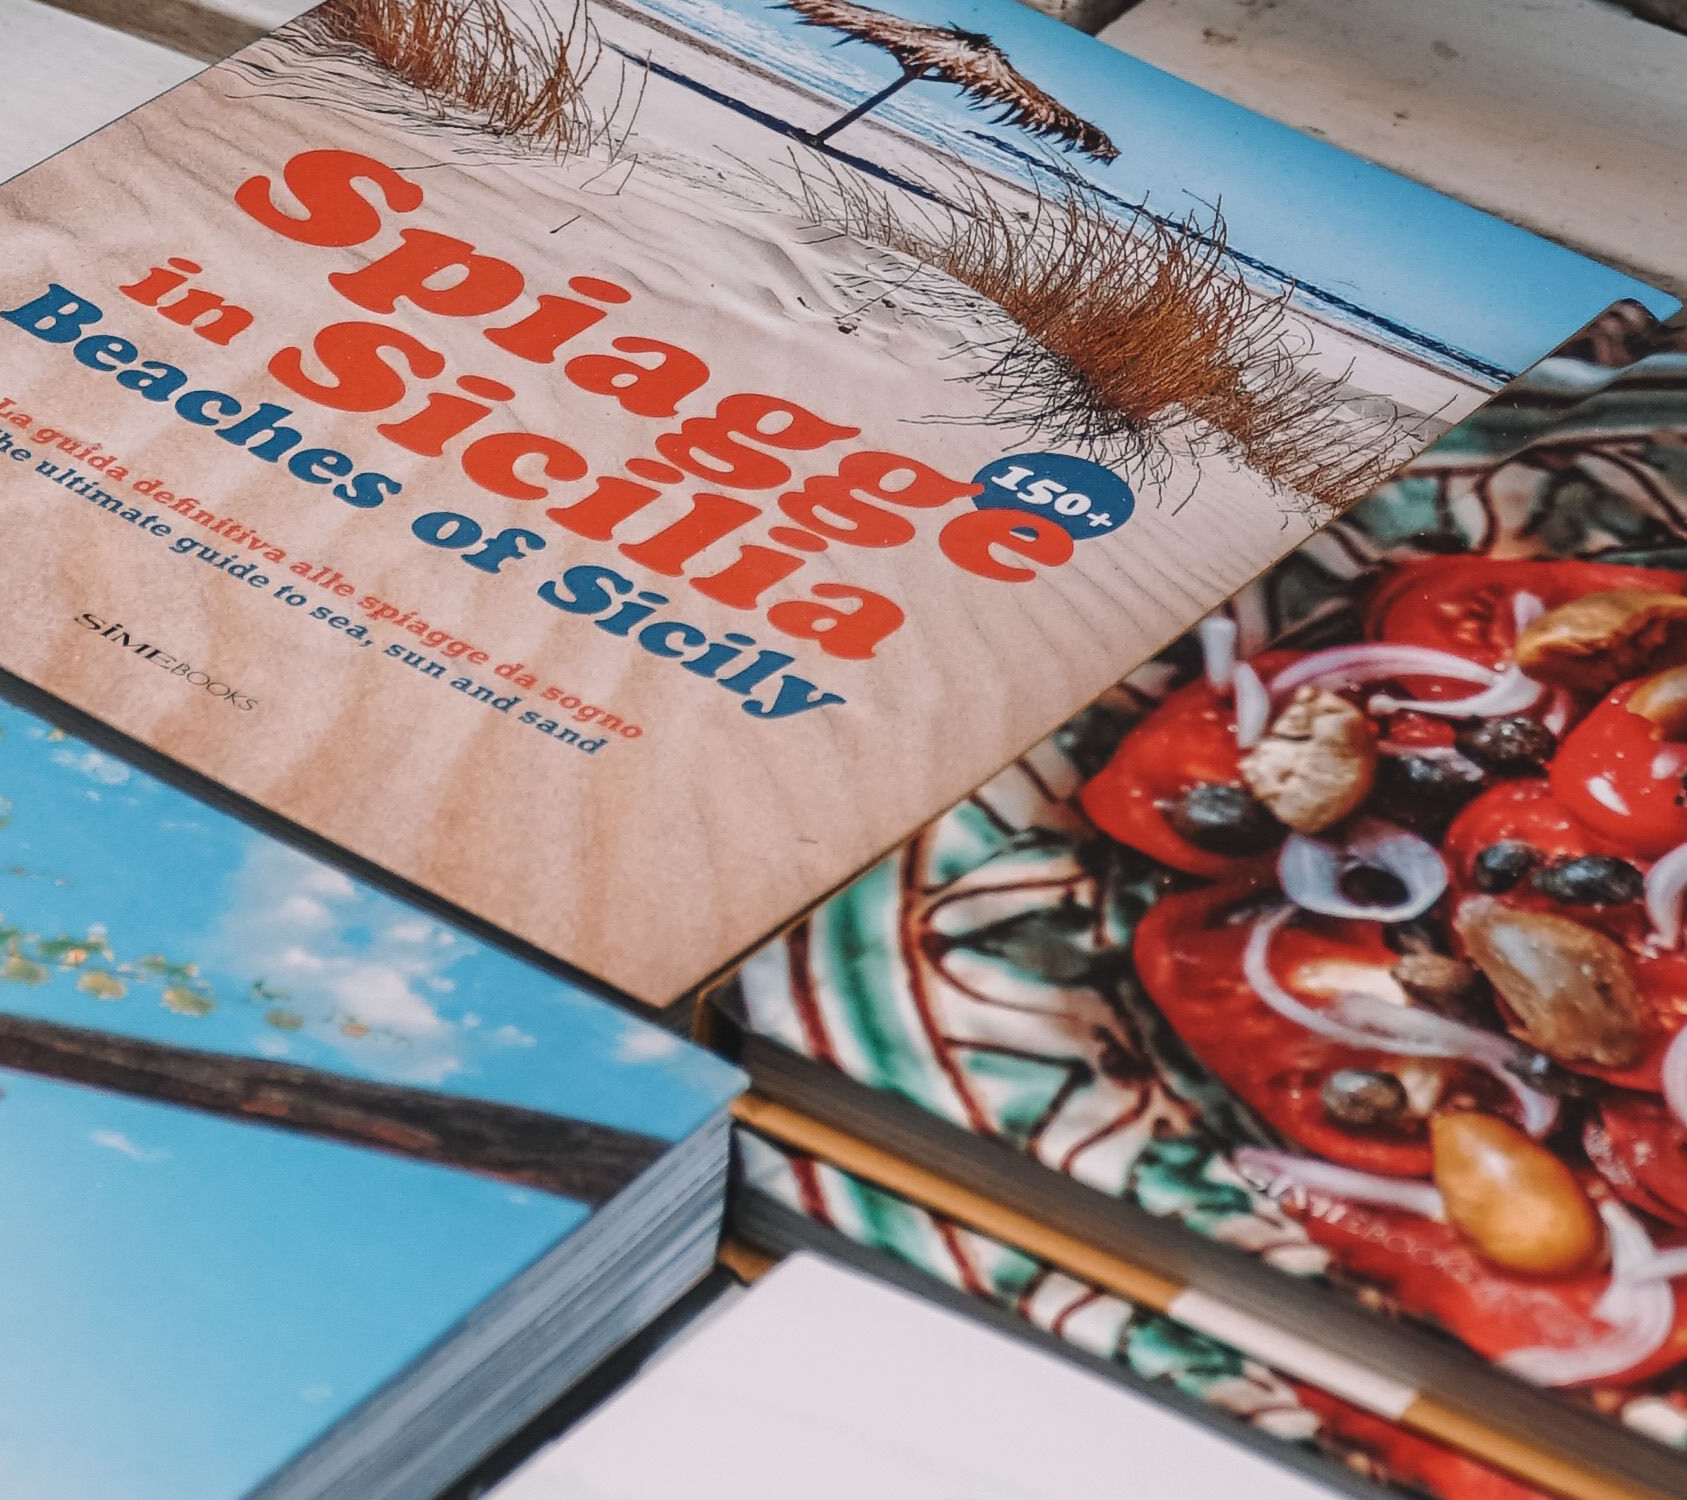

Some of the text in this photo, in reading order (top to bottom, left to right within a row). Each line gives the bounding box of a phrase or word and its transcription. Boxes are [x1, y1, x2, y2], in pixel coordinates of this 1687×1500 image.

[118, 256, 908, 662] in Sicilia
[233, 147, 1076, 584] Spiagge
[990, 465, 1114, 528] 150+
[28, 424, 130, 483] guida
[132, 478, 288, 564] definitiva
[289, 558, 356, 598] alle
[356, 593, 490, 667] spiagge
[493, 662, 539, 692] da
[539, 683, 644, 742] sogno
[34, 459, 173, 539] ultimate
[167, 535, 272, 590] guide
[272, 583, 309, 609] to
[308, 604, 375, 649] sea,
[382, 641, 448, 680] sun
[449, 675, 523, 715] and
[517, 707, 609, 757] sand
[411, 508, 547, 574] of
[537, 563, 849, 722] Sicily
